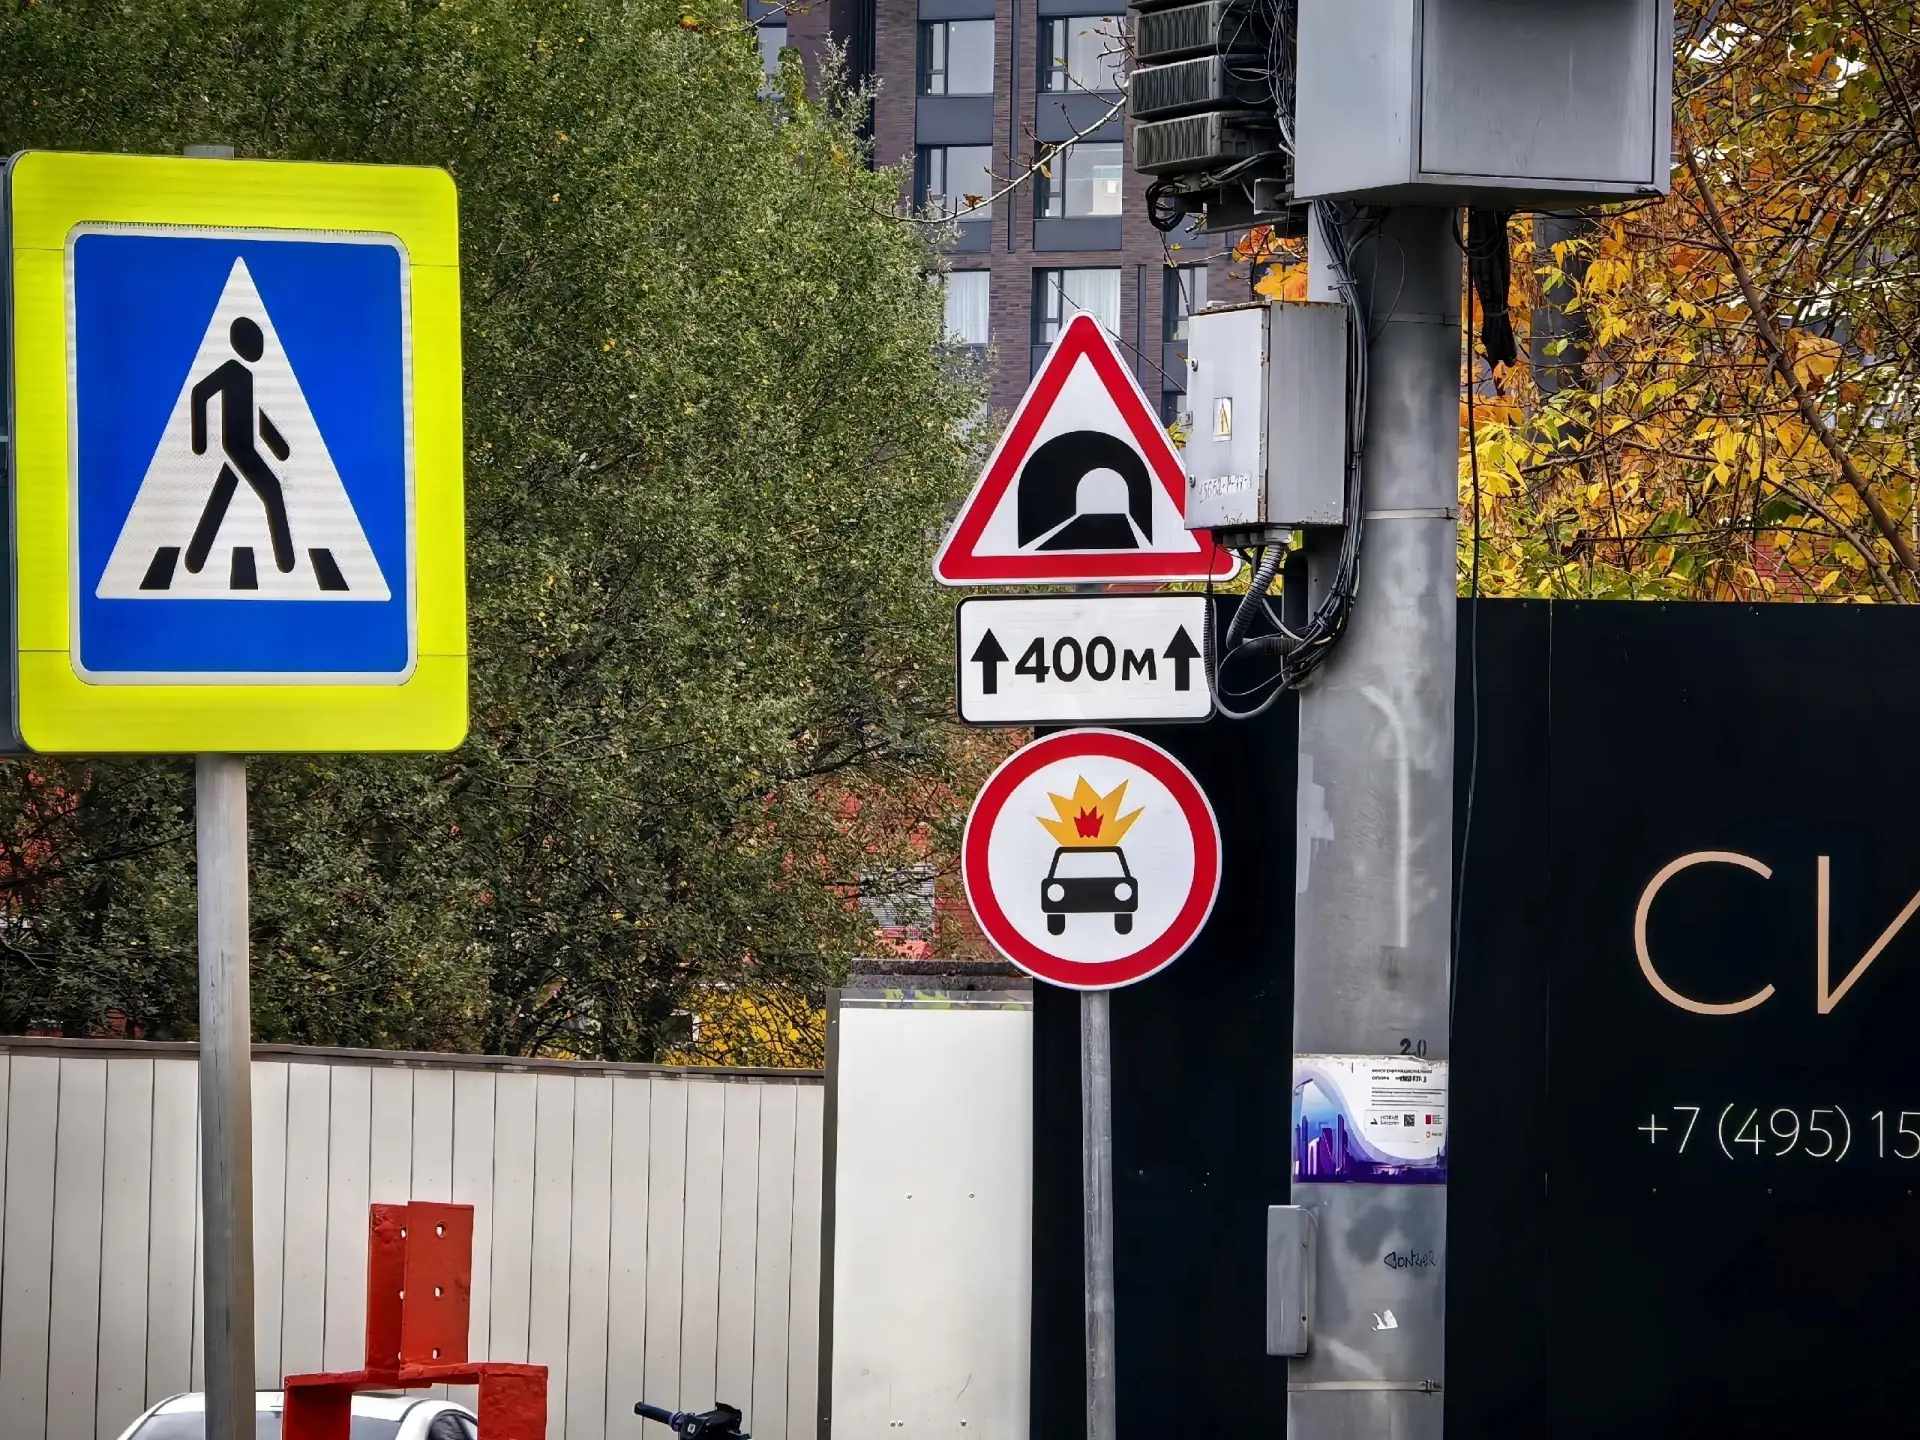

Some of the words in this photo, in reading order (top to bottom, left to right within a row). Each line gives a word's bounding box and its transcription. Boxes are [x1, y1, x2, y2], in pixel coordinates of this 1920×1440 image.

[1637, 1106, 1700, 1154] +7
[1718, 1102, 1851, 1163] (495)
[1870, 1110, 1920, 1160] 15
